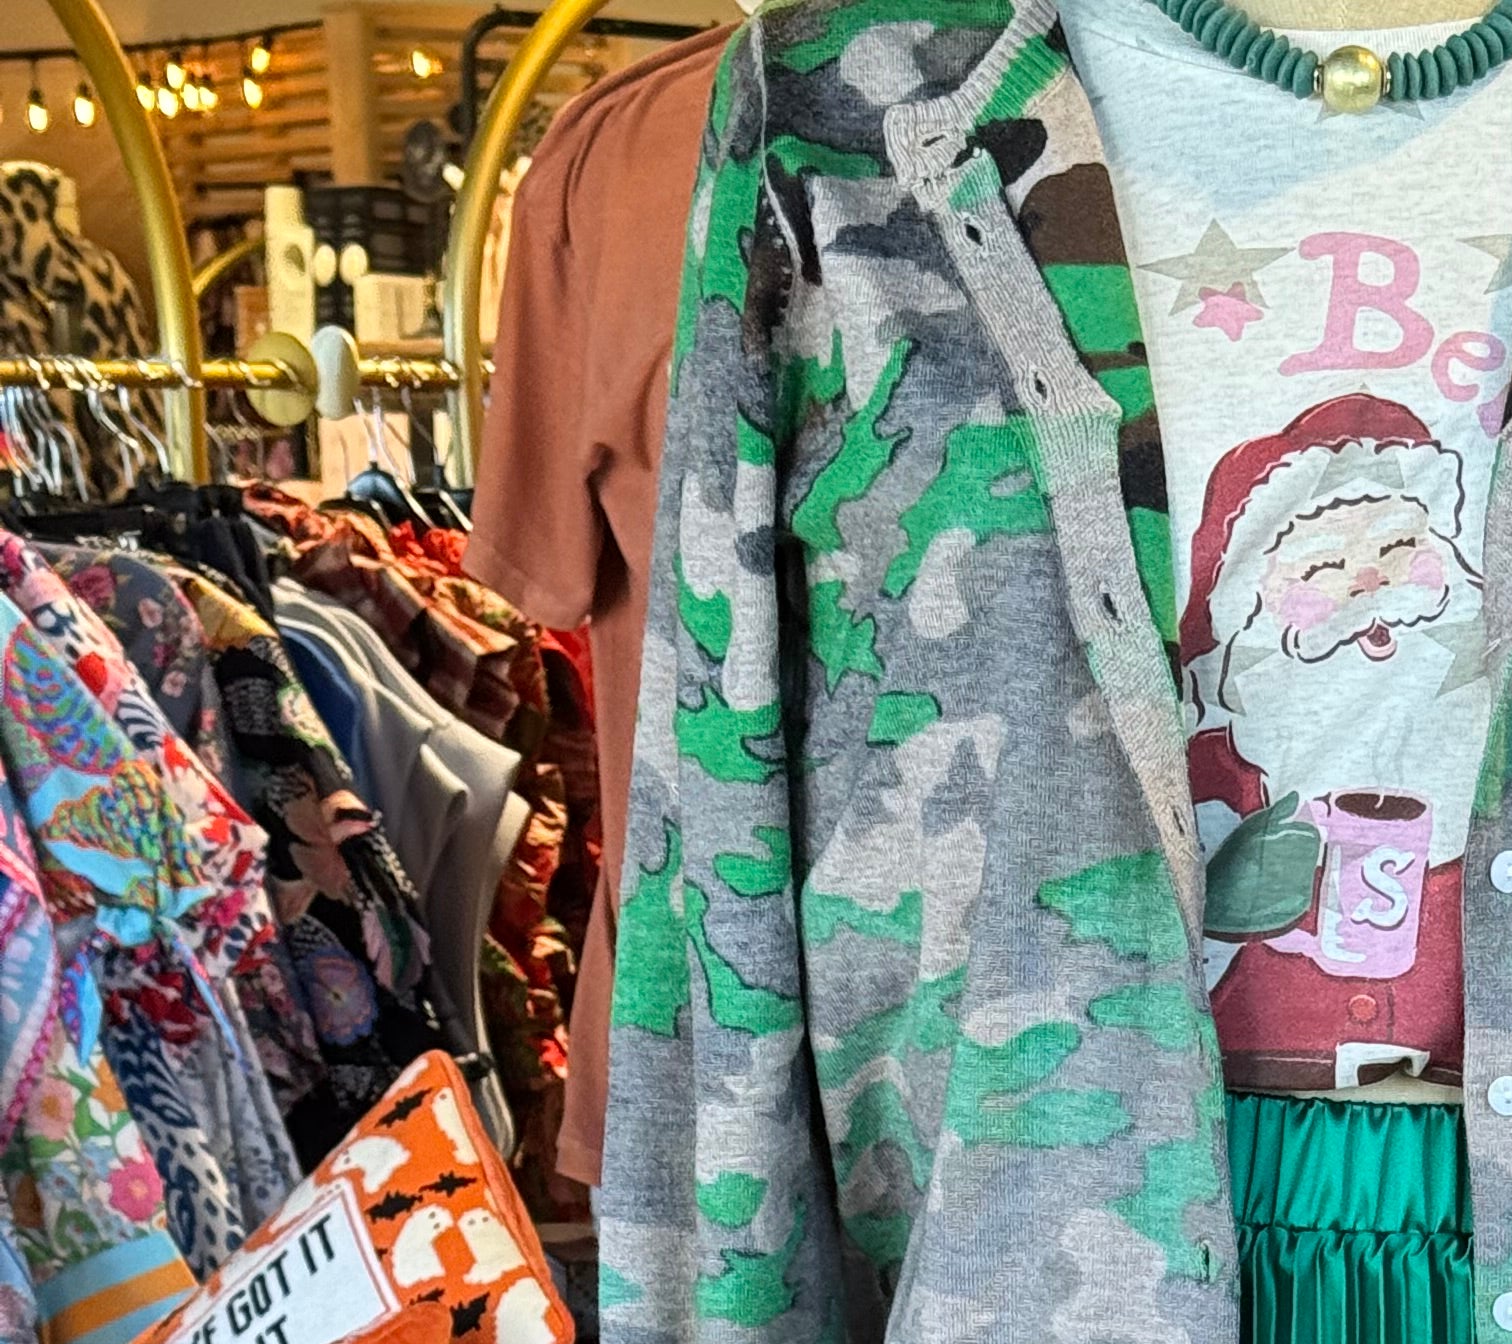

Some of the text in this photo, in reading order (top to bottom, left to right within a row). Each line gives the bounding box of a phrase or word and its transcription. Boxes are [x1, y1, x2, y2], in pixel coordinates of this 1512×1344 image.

[1278, 231, 1508, 438] Be
[1350, 844, 1416, 932] S
[226, 1250, 291, 1336] GOT
[299, 1214, 335, 1275] IT
